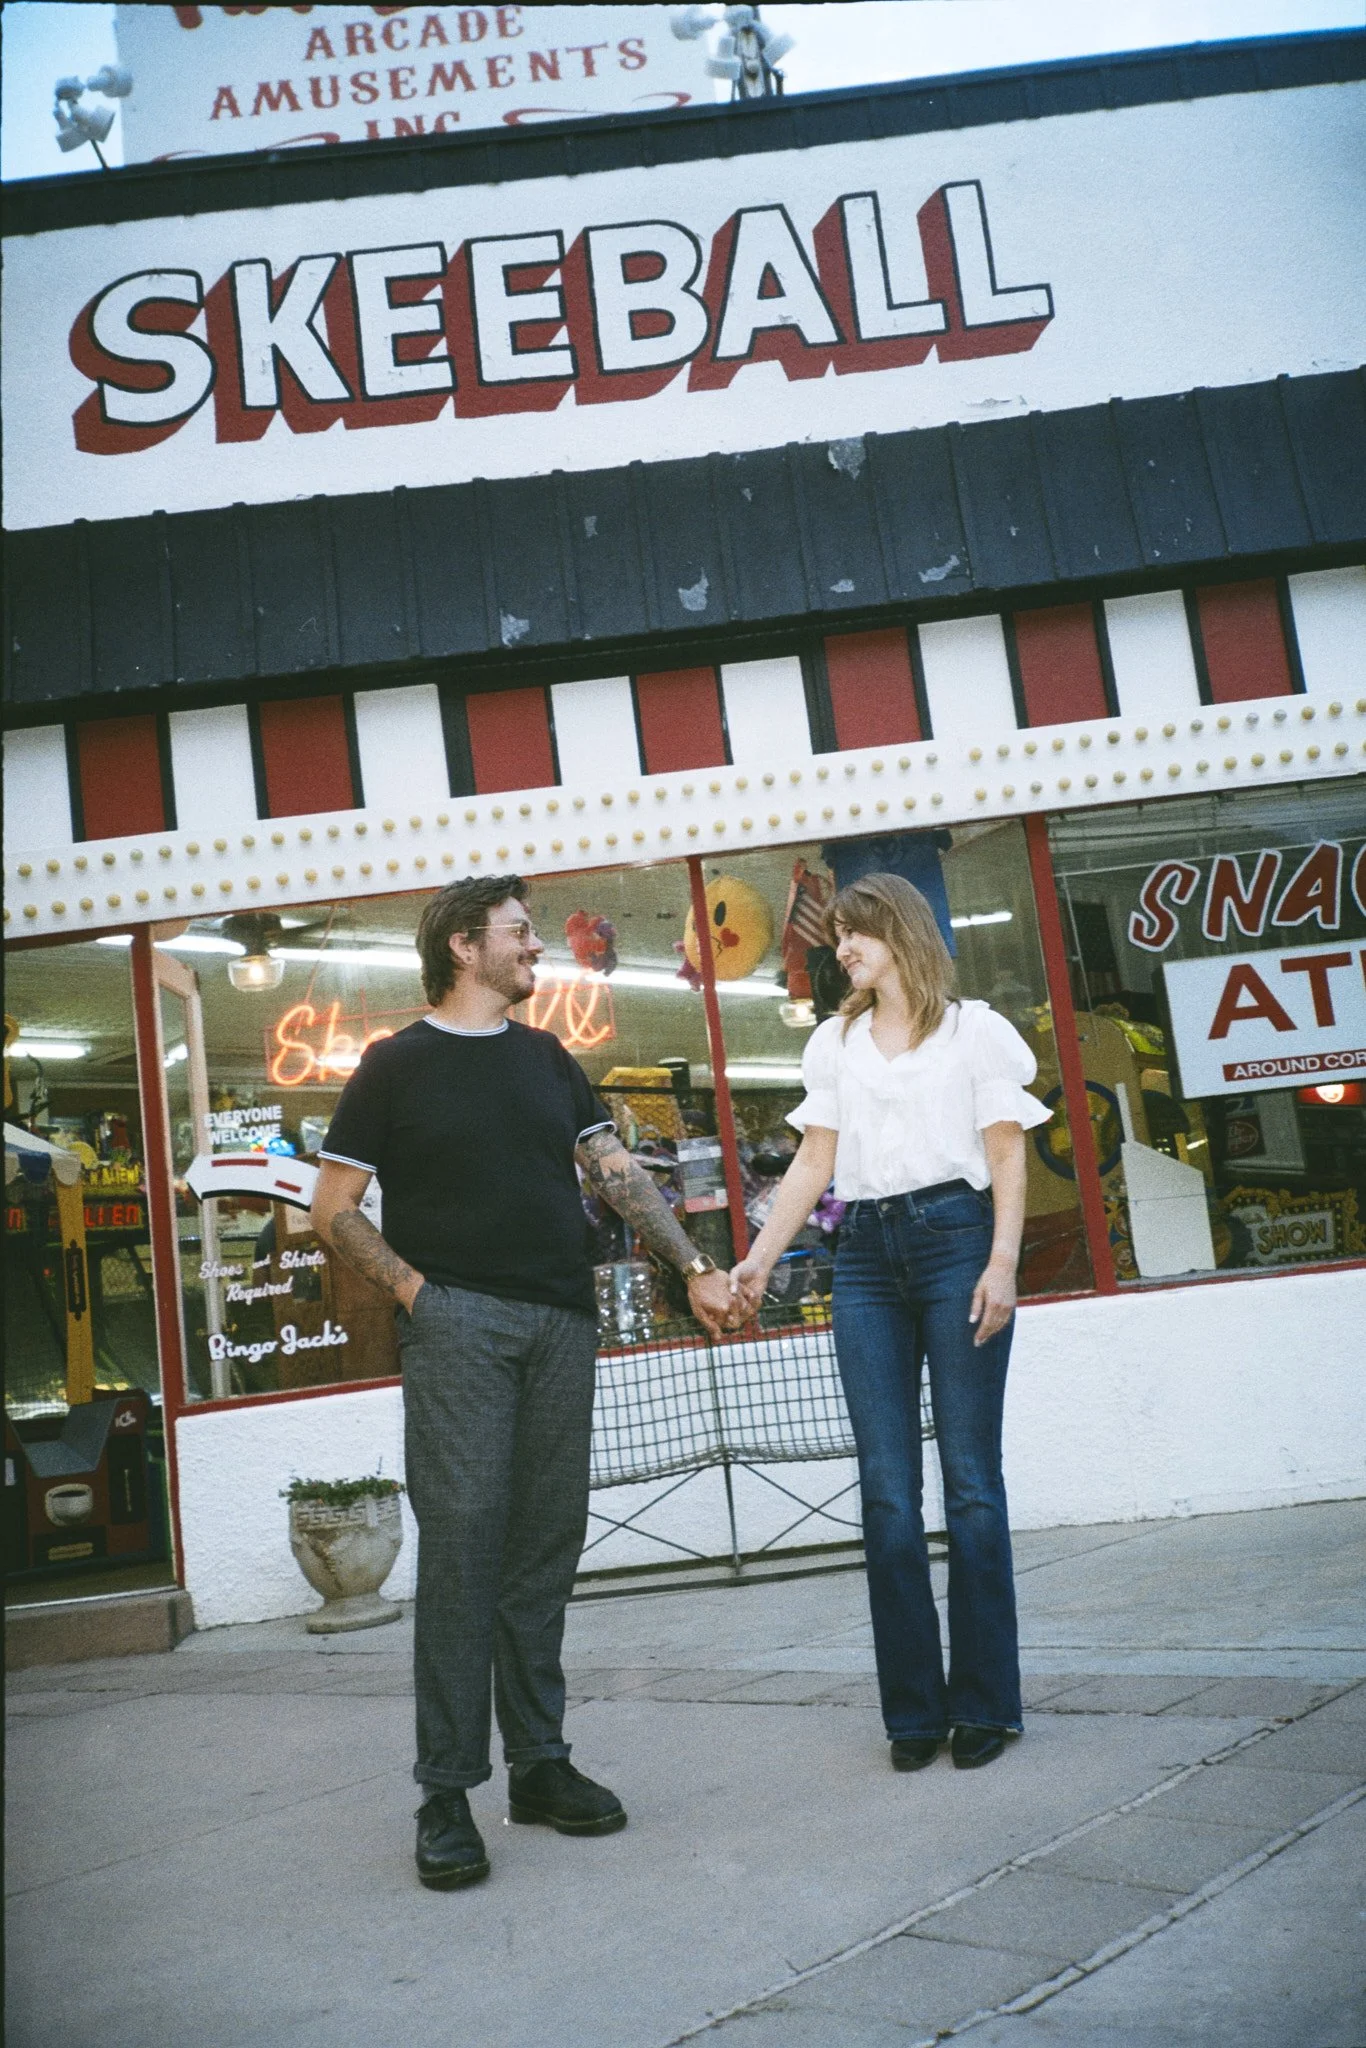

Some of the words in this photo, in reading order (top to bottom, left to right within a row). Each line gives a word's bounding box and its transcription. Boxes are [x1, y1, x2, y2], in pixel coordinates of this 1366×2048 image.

[304, 5, 524, 61] ARCADE
[208, 37, 648, 121] AMUSEMENTS
[68, 178, 1054, 455] SKEEBALL
[1128, 838, 1366, 952] SNA
[1207, 949, 1366, 1041] AT
[1232, 1060, 1321, 1080] AROUND
[203, 1105, 283, 1129] EVERYONE
[208, 1123, 281, 1146] WELCOME
[1256, 1218, 1328, 1256] SHOW
[198, 1260, 245, 1280] Shoes
[279, 1249, 327, 1270] Shirts
[226, 1275, 294, 1306] Required
[208, 1333, 279, 1364] Bingo
[280, 1320, 349, 1356] Jack's
